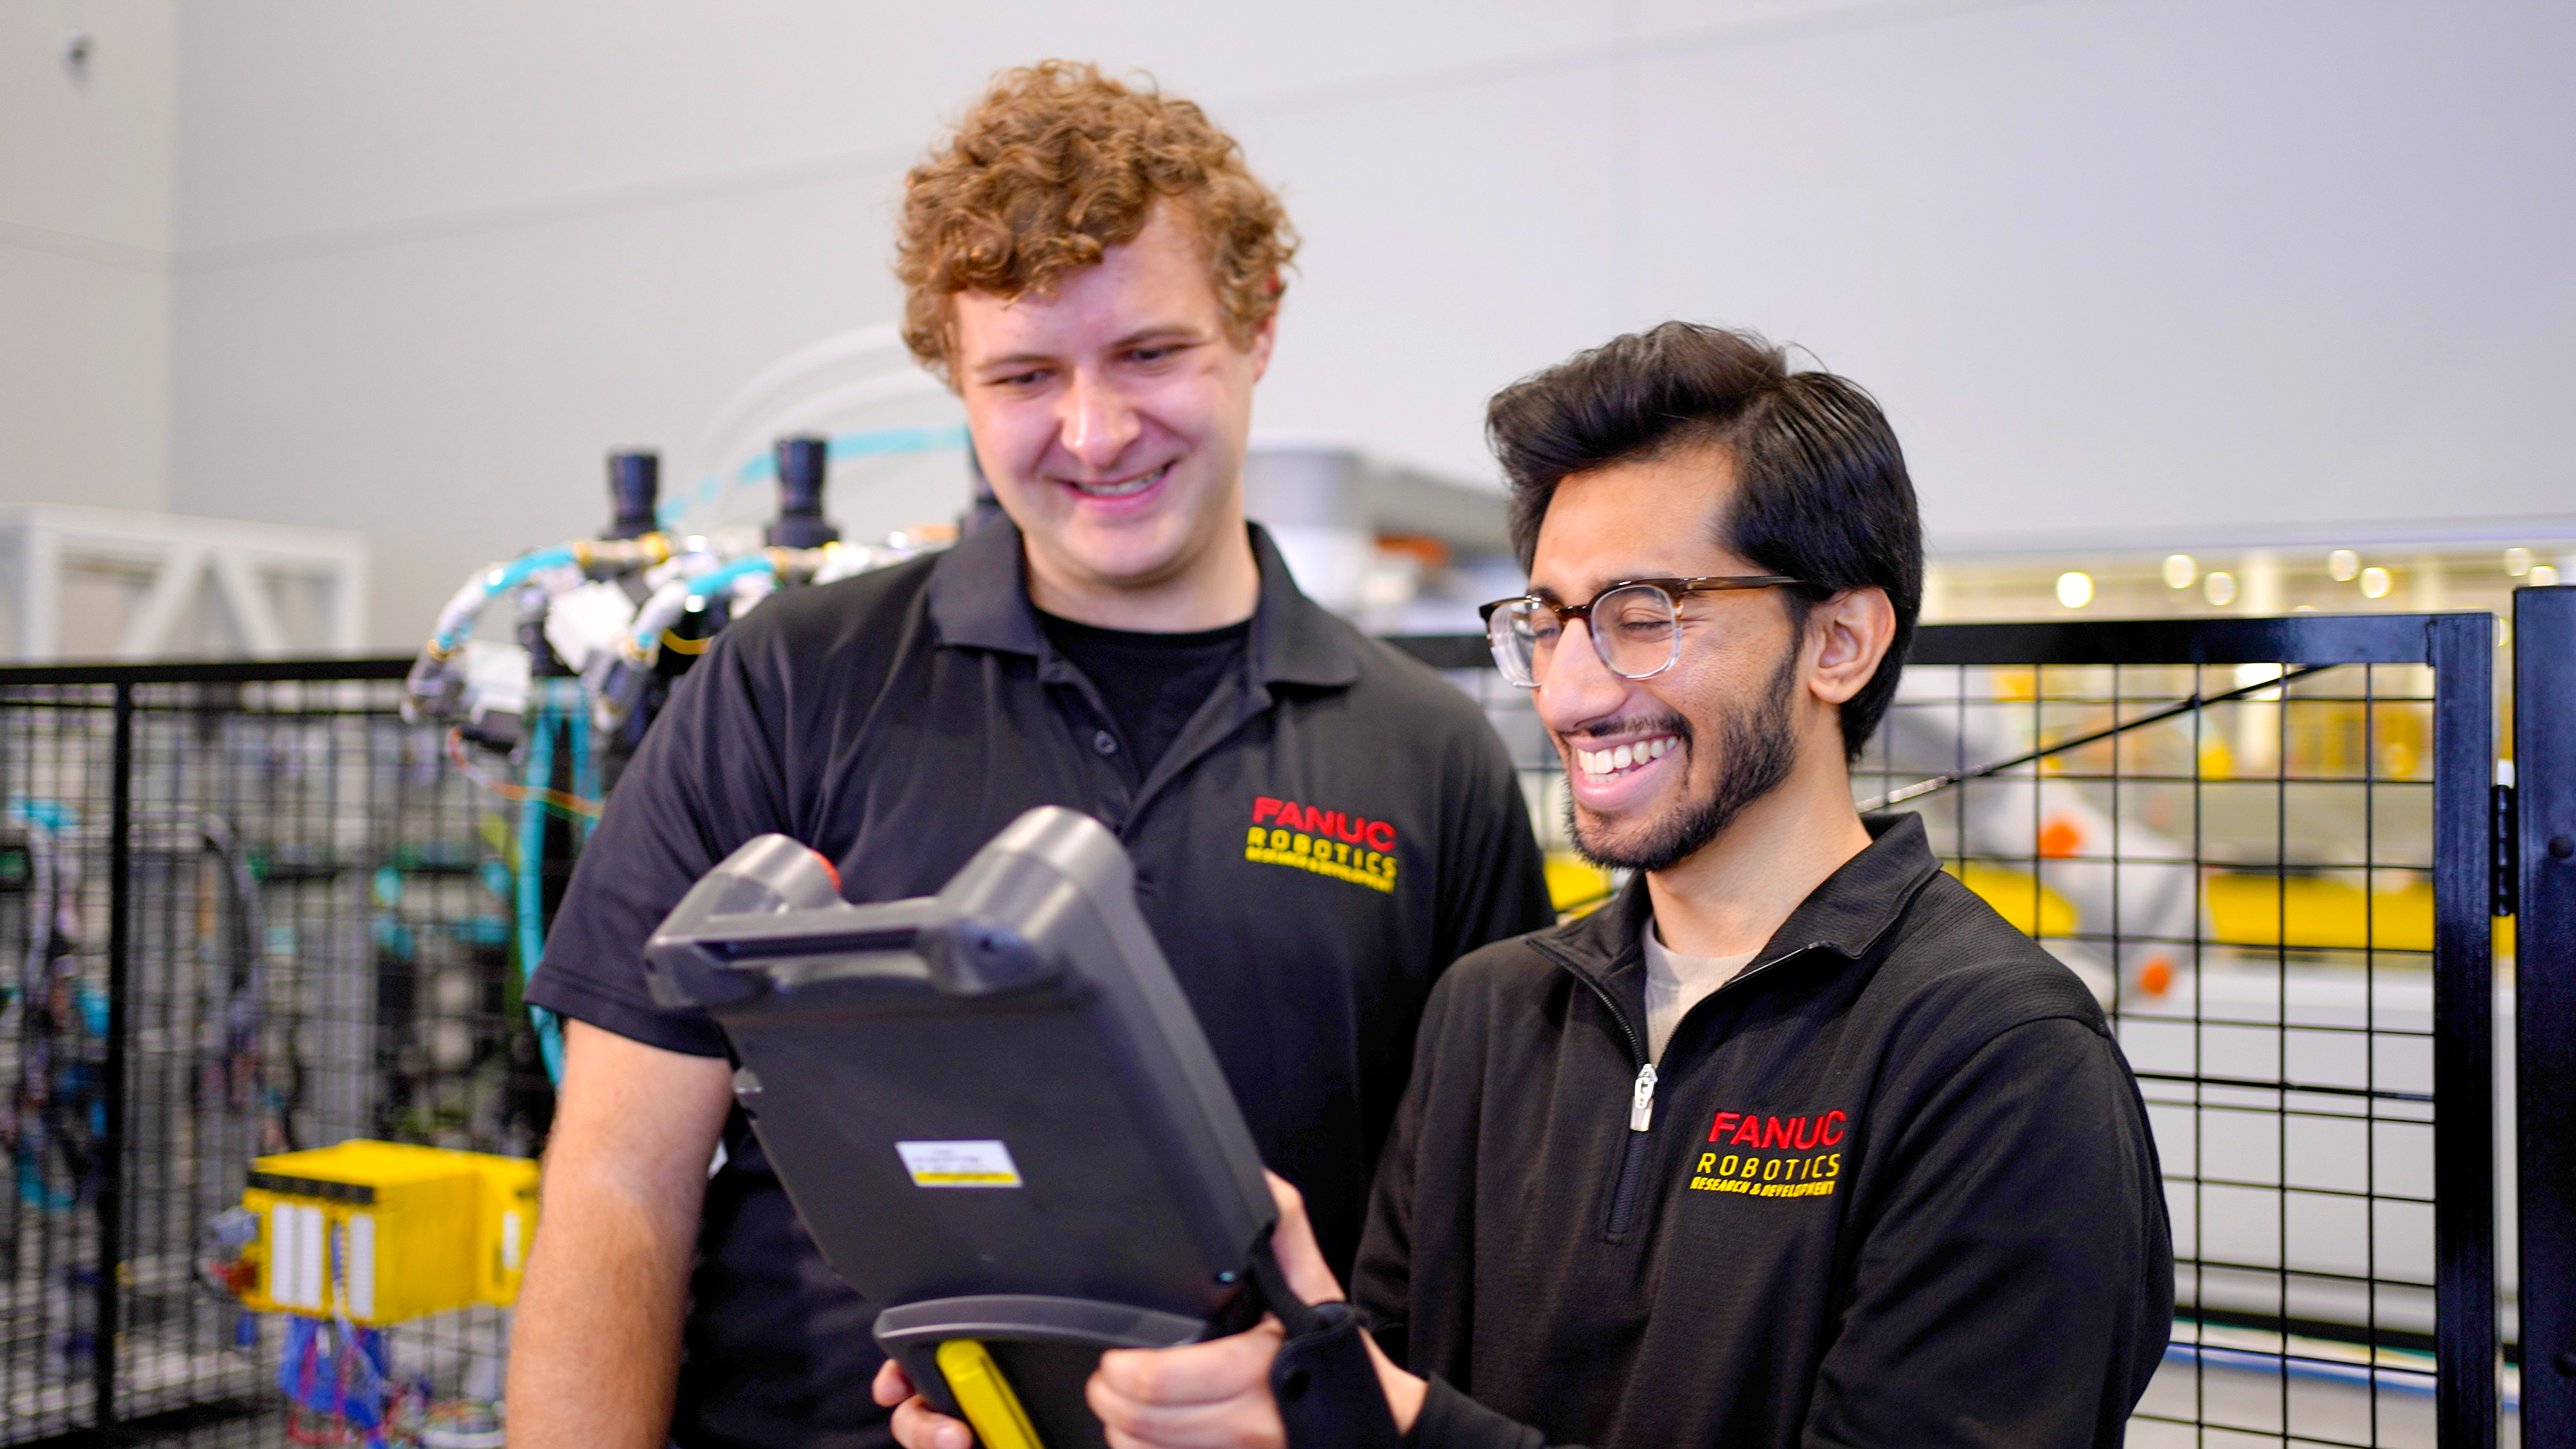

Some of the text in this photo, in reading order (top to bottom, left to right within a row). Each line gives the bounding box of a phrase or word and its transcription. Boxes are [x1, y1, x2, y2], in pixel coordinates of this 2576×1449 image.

[1252, 796, 1396, 851] FANUC
[1246, 826, 1397, 879] ROBOTICS
[1708, 1110, 1845, 1150] FANUC
[1690, 1177, 1751, 1193] RESEARCH
[1749, 1183, 1762, 1195] &
[1697, 1152, 1841, 1180] ROBOTICS
